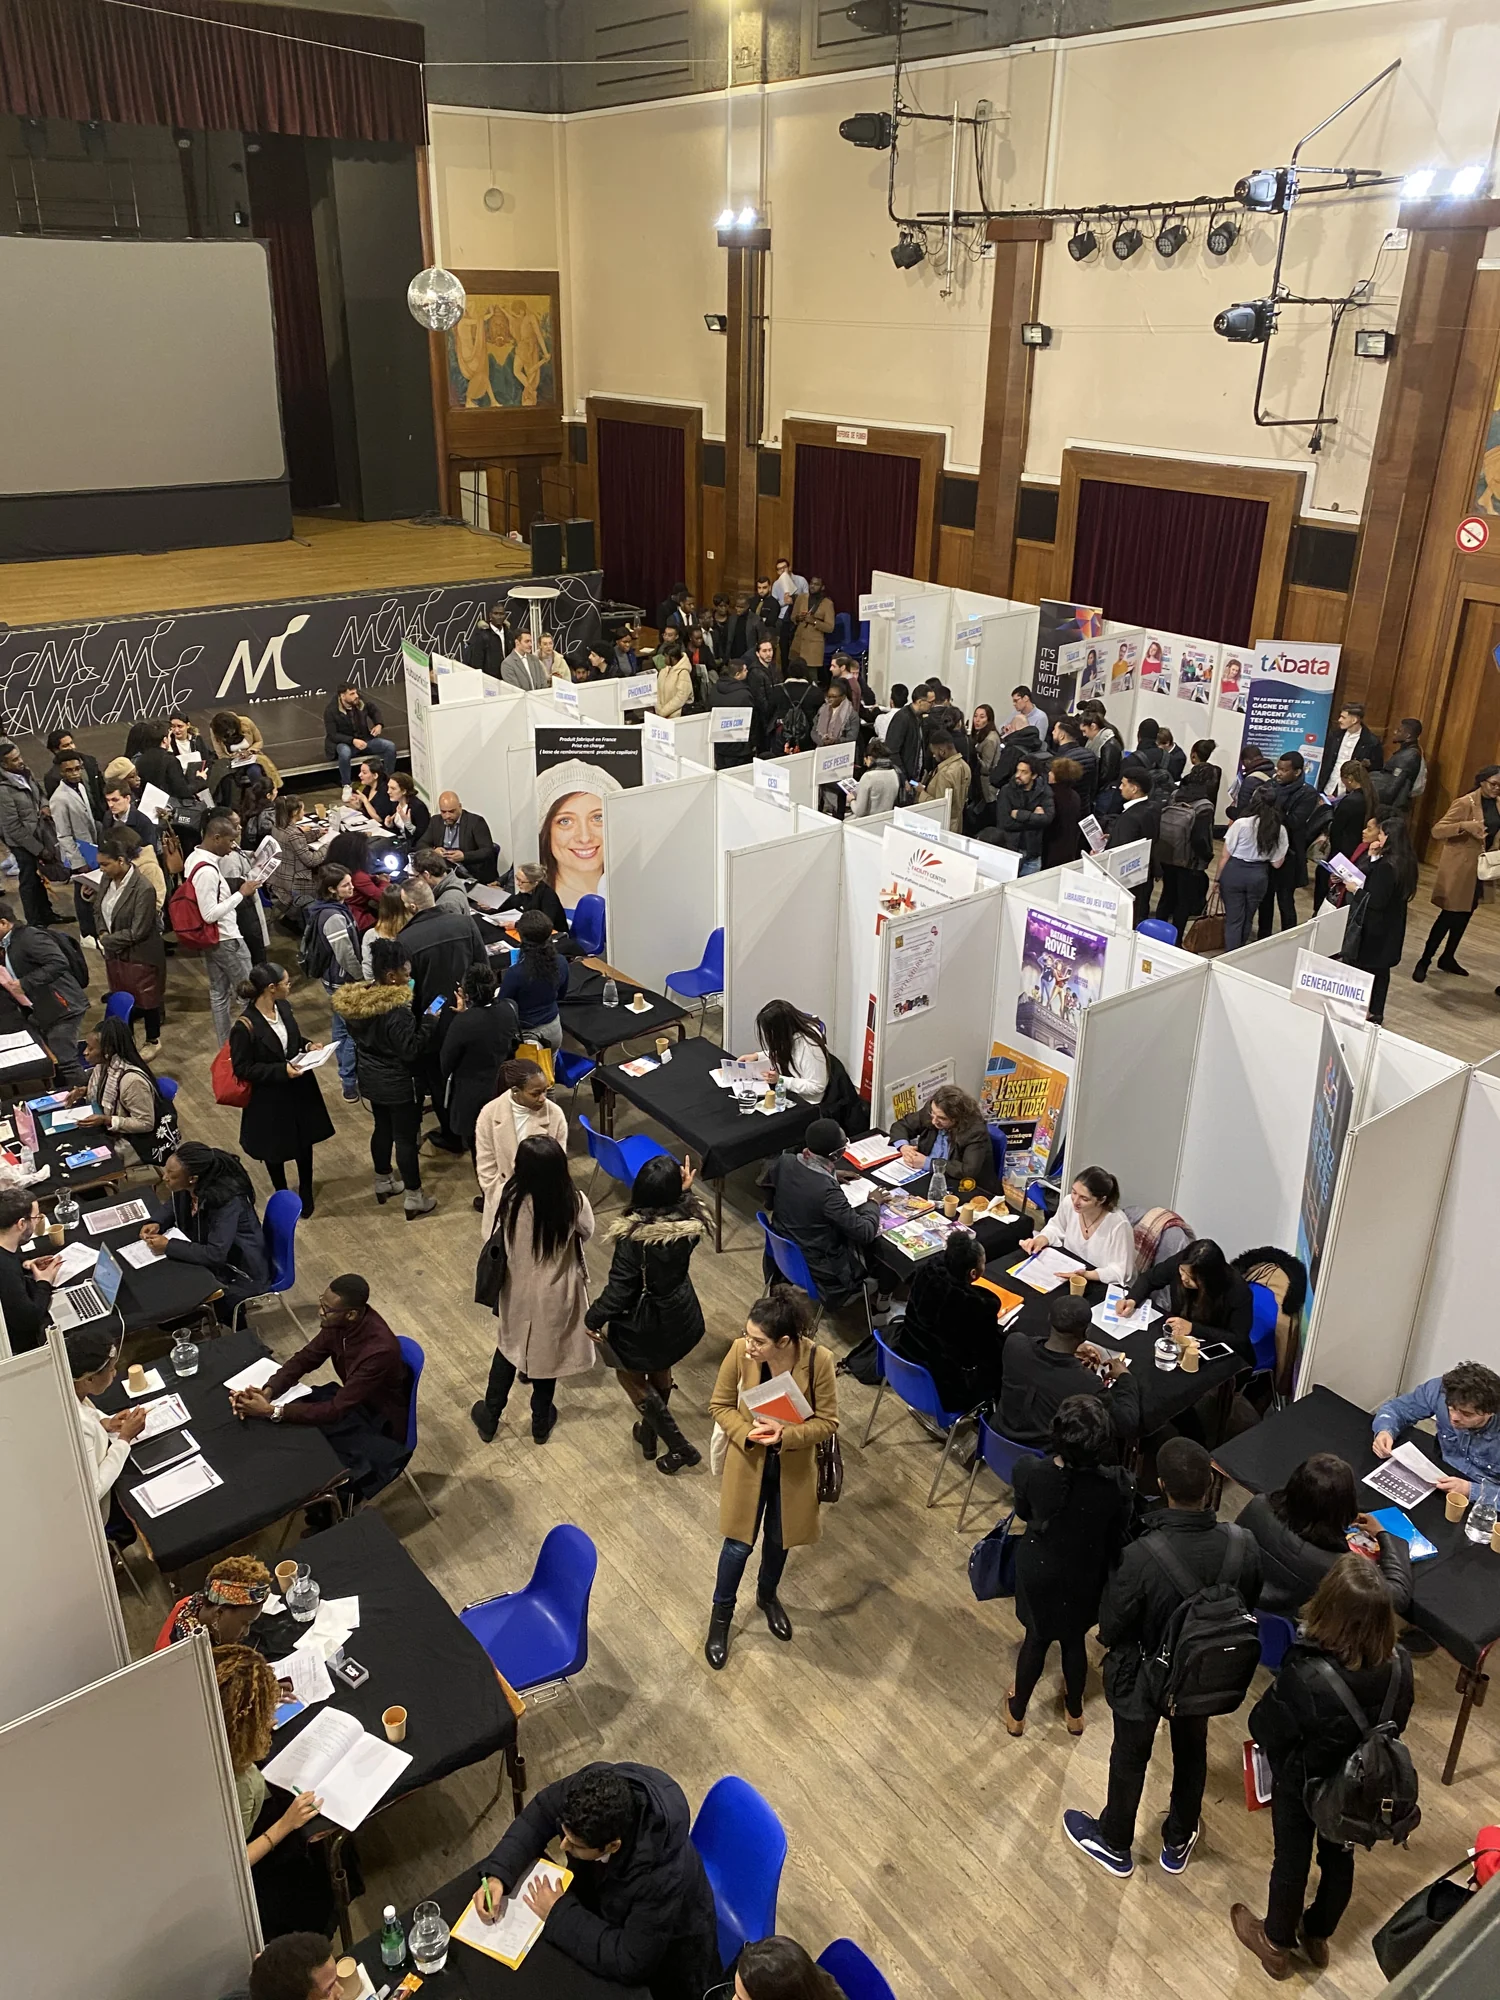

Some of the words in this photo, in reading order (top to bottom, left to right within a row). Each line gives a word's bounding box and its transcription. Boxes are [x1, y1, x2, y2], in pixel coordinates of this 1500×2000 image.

[1041, 648, 1056, 658] IT'S
[1038, 672, 1060, 685] WITH
[1036, 685, 1060, 698] LIGHT
[1249, 725, 1304, 733] PERSONNELLES
[1264, 718, 1299, 726] DONNÉES
[912, 866, 929, 876] FACILITY
[930, 872, 947, 883] CENTER
[1064, 892, 1086, 904] LIBRAIRIE
[1086, 897, 1093, 905] DU
[1093, 898, 1102, 907] JEU
[1050, 929, 1074, 944] BATAILLE
[1044, 935, 1077, 960] ROYALE
[1300, 973, 1365, 1002] GENERATIONNEL
[998, 1075, 1050, 1099] L'ESSENTIEL
[893, 1085, 915, 1106] GUIDE
[999, 1098, 1021, 1118] JEUX
